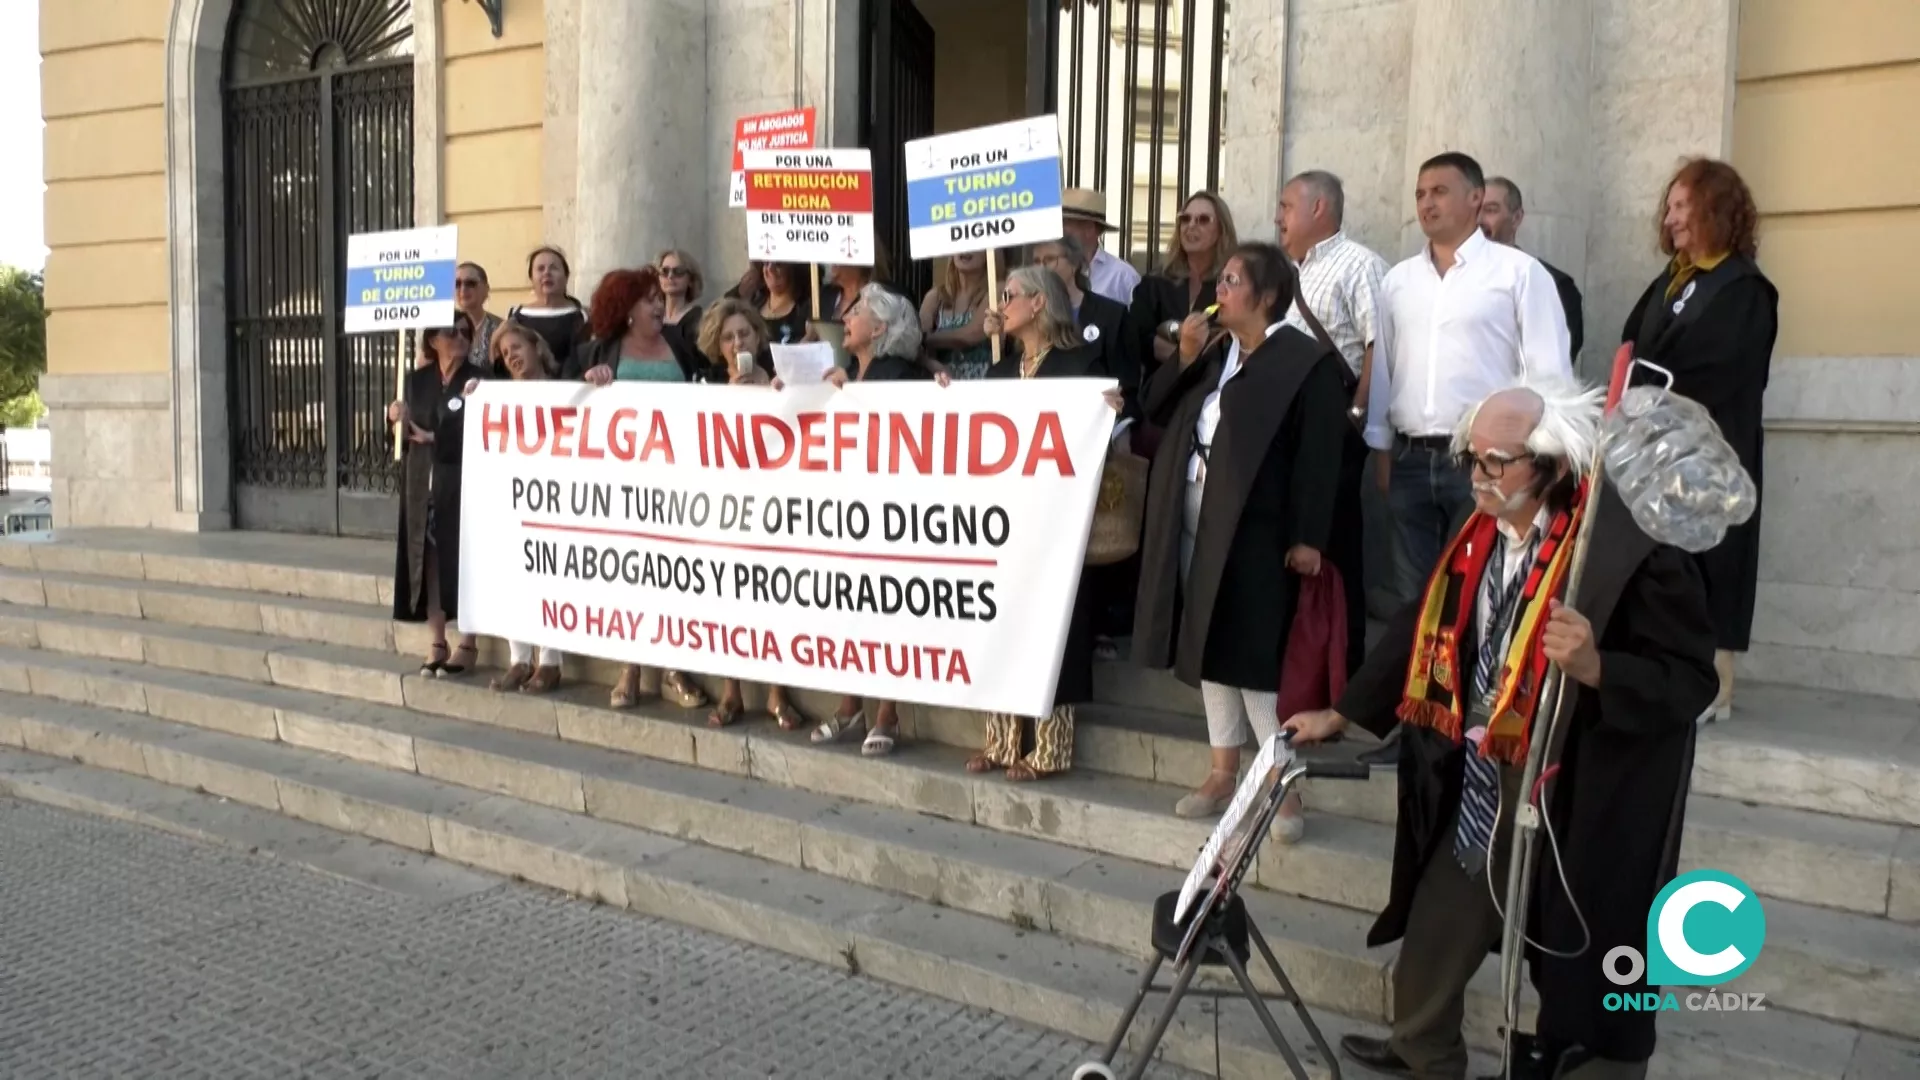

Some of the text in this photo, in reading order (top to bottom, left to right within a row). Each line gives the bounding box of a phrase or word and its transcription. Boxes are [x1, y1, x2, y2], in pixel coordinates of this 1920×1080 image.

[743, 114, 805, 134] SIN ABOGADOS
[738, 131, 809, 152] NO HAY JUSTICIA
[775, 155, 833, 167] POR UNA
[950, 148, 1008, 170] POR UN
[753, 172, 859, 190] RETRIBUCIÓN
[944, 168, 1016, 195] TURNO
[782, 193, 831, 209] DIGNA
[931, 190, 1034, 221] DE OFICIO
[761, 213, 854, 227] DEL TURNO DE
[950, 217, 1015, 242] DIGNO
[786, 229, 829, 242] OFICIO
[379, 249, 420, 262] POR UN
[373, 265, 425, 283] TURNO
[362, 284, 435, 303] DE OFICIO
[374, 305, 420, 321] DIGNO
[482, 403, 1076, 477] HUELGA INDEFINIDA
[513, 477, 1010, 547] POR UN TURNO DE OFICIO DIGNO
[524, 538, 997, 622] SIN ABOGADOS Y PROCURADORES
[542, 598, 971, 685] NO HAY JUSTICIA GRATUITA
